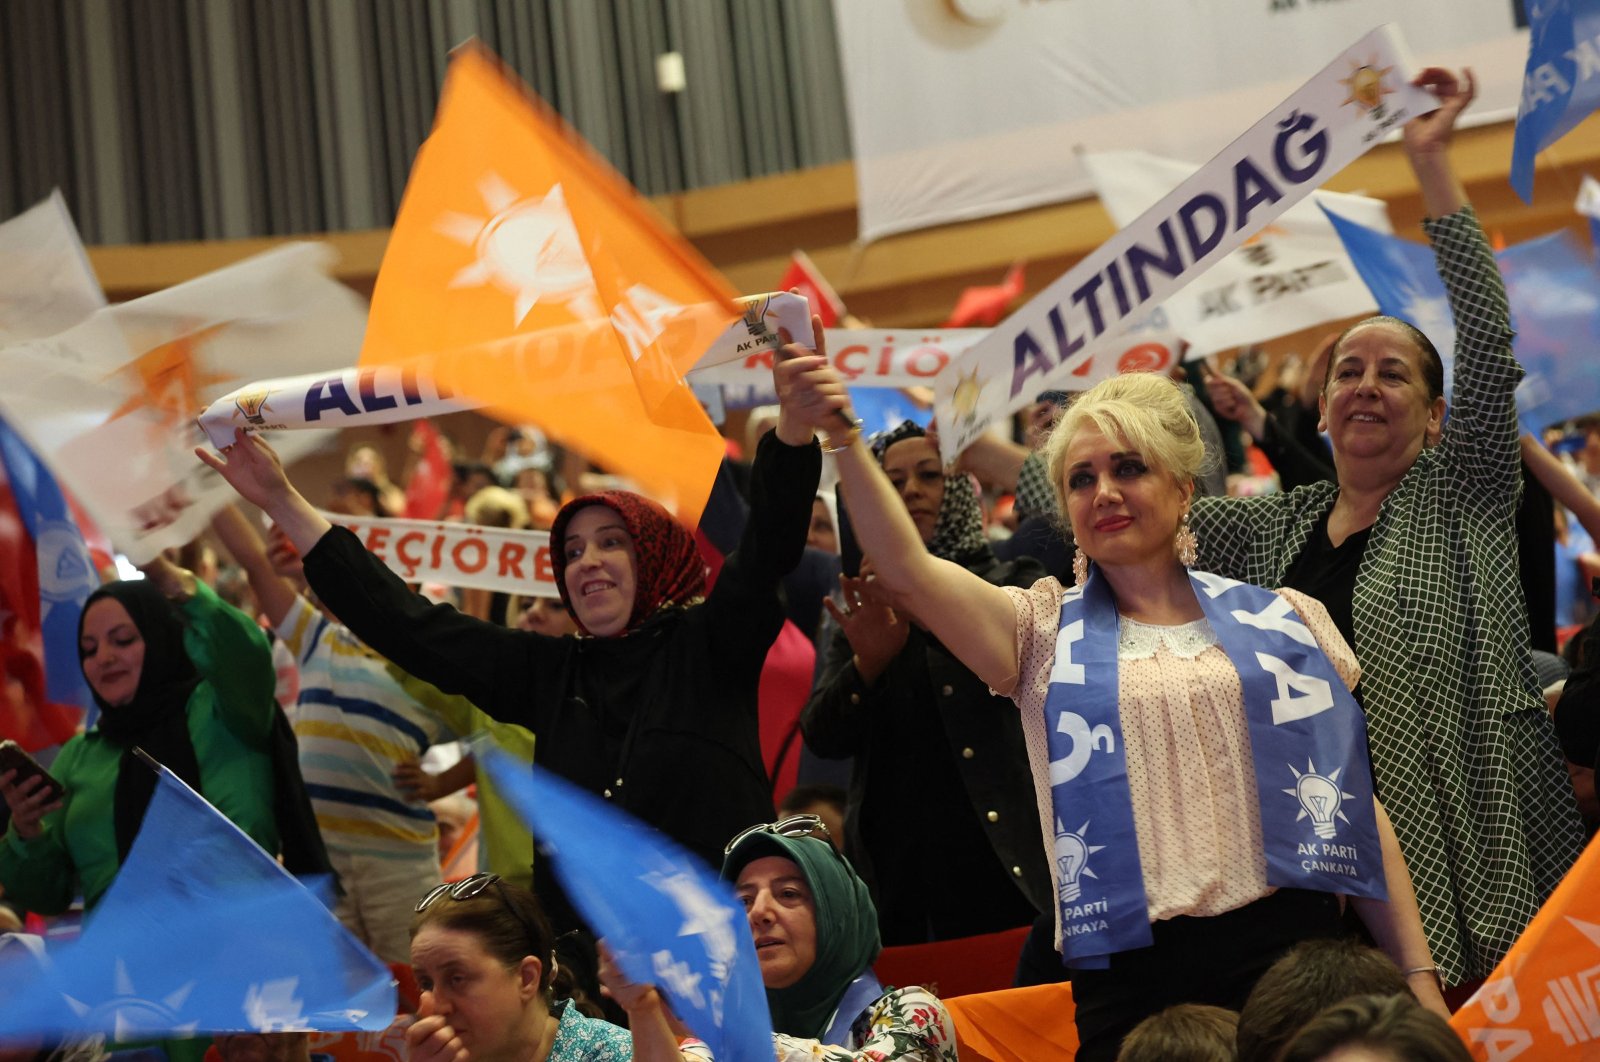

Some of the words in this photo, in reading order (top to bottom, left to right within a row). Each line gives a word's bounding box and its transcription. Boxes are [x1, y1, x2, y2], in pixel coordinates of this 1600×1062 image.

[1010, 108, 1331, 400] ALTINDAĞ
[736, 342, 751, 353] AK
[754, 334, 777, 346] PAR
[346, 524, 556, 583] EÇİÖRE
[1297, 842, 1319, 856] AK
[1322, 843, 1358, 860] PARTİ
[1301, 860, 1357, 876] ÇANKAYA
[1064, 897, 1108, 921] PARTİ
[1062, 919, 1109, 938] NKAYA
